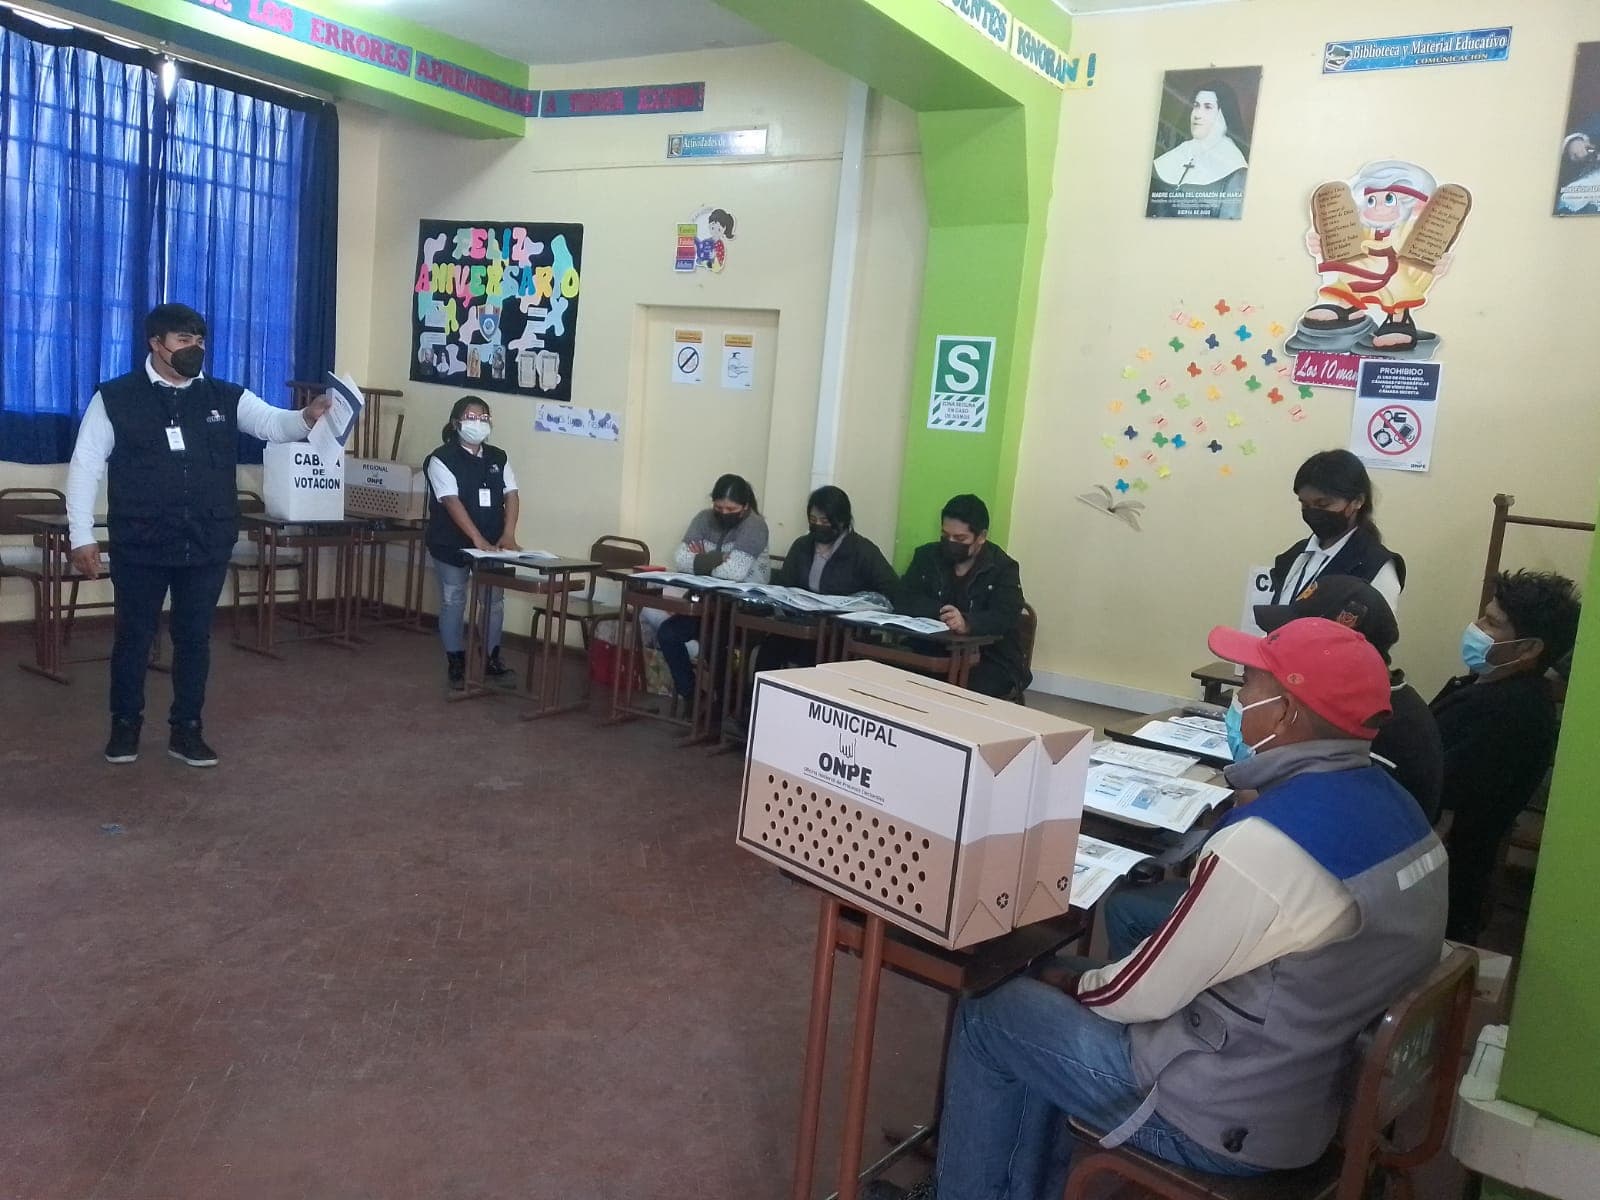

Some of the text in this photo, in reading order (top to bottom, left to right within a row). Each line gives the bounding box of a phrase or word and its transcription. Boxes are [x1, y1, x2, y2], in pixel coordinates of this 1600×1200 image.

[249, 0, 294, 32] LOS
[310, 17, 410, 72] ERRORES
[952, 0, 1007, 42] ENTES
[1016, 26, 1080, 84] IGNORAN
[1353, 33, 1507, 59] Biblioteca y Material Educativo
[452, 227, 527, 261] FELIZ
[415, 263, 579, 298] ANIVERSARIO
[945, 345, 980, 392] S
[1296, 355, 1318, 378] Los
[1320, 359, 1338, 379] 10
[1380, 367, 1423, 376] PROHIBIDO
[294, 477, 341, 490] VOTACION
[363, 464, 388, 473] REGIONAL
[1256, 574, 1273, 592] C
[808, 701, 898, 748] MUNICIPAL
[818, 752, 872, 789] ONPE
